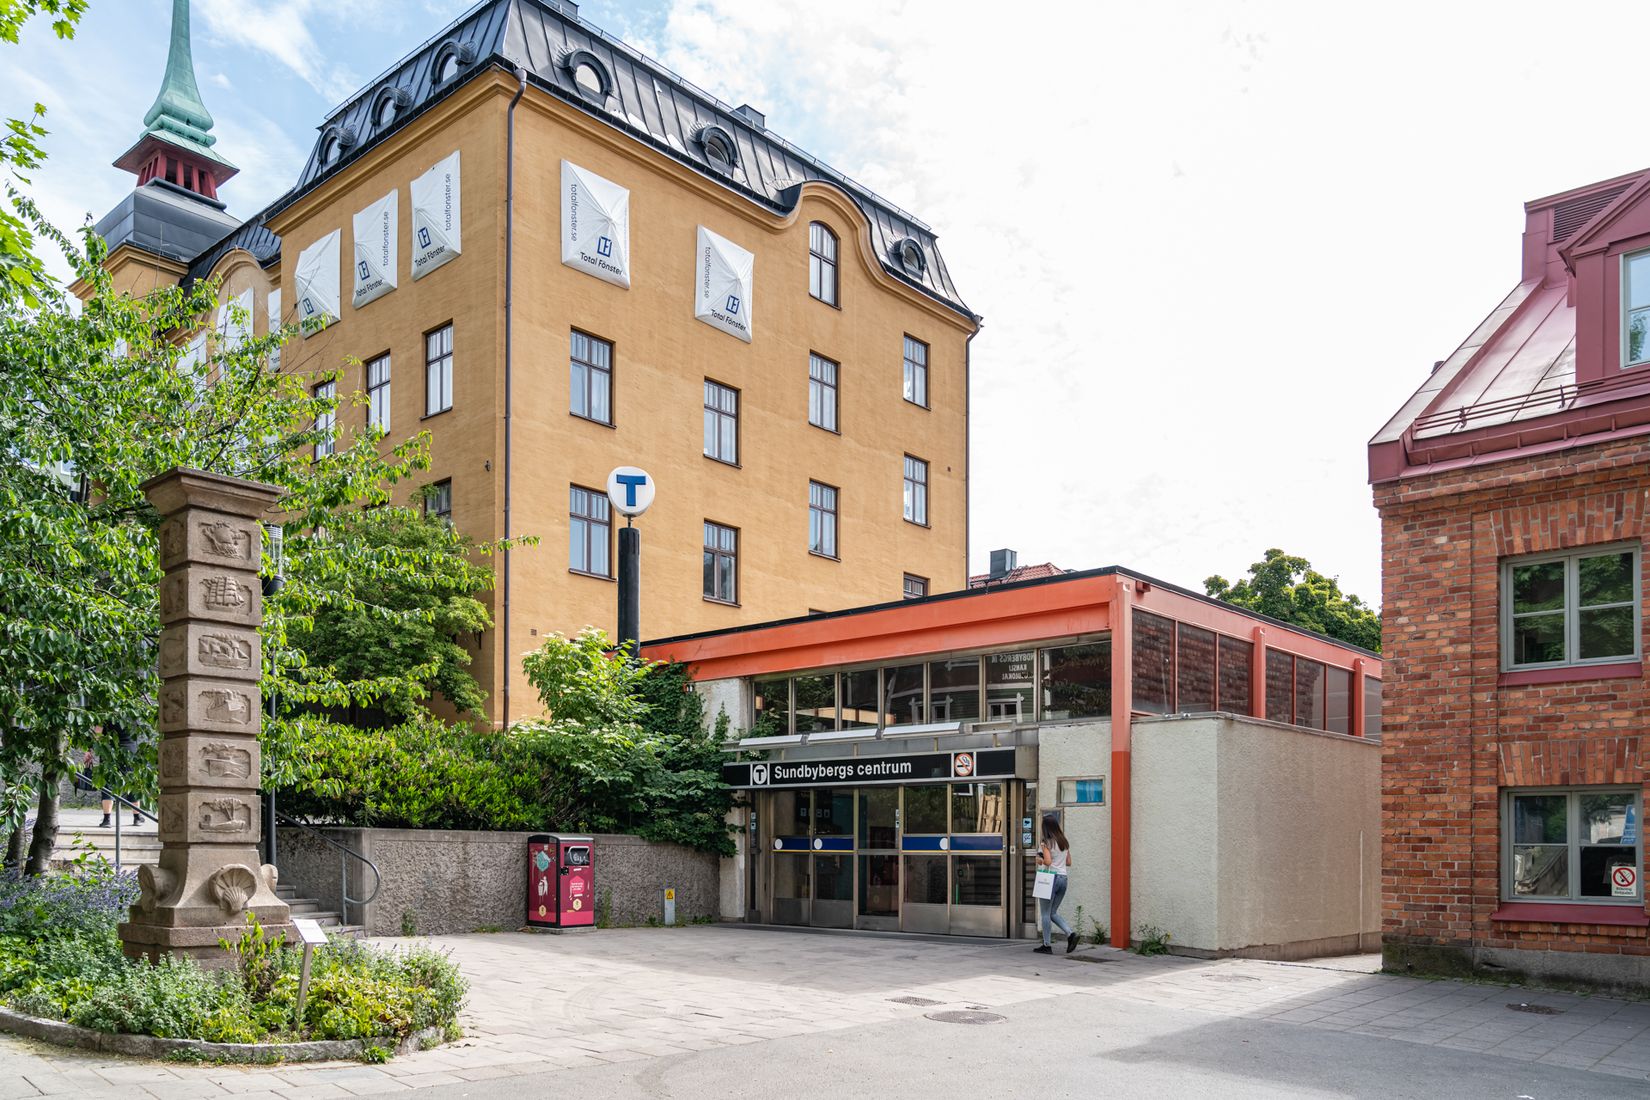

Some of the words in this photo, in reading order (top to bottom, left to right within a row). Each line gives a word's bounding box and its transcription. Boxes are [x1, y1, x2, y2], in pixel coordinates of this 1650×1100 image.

[571, 184, 579, 241] totalfonster.se
[414, 254, 428, 267] Total
[580, 251, 597, 265] Total
[598, 259, 623, 275] Fönster
[710, 309, 725, 321] Total
[616, 474, 646, 507] T
[774, 763, 854, 780] Sundbybergs
[857, 761, 912, 775] centrum
